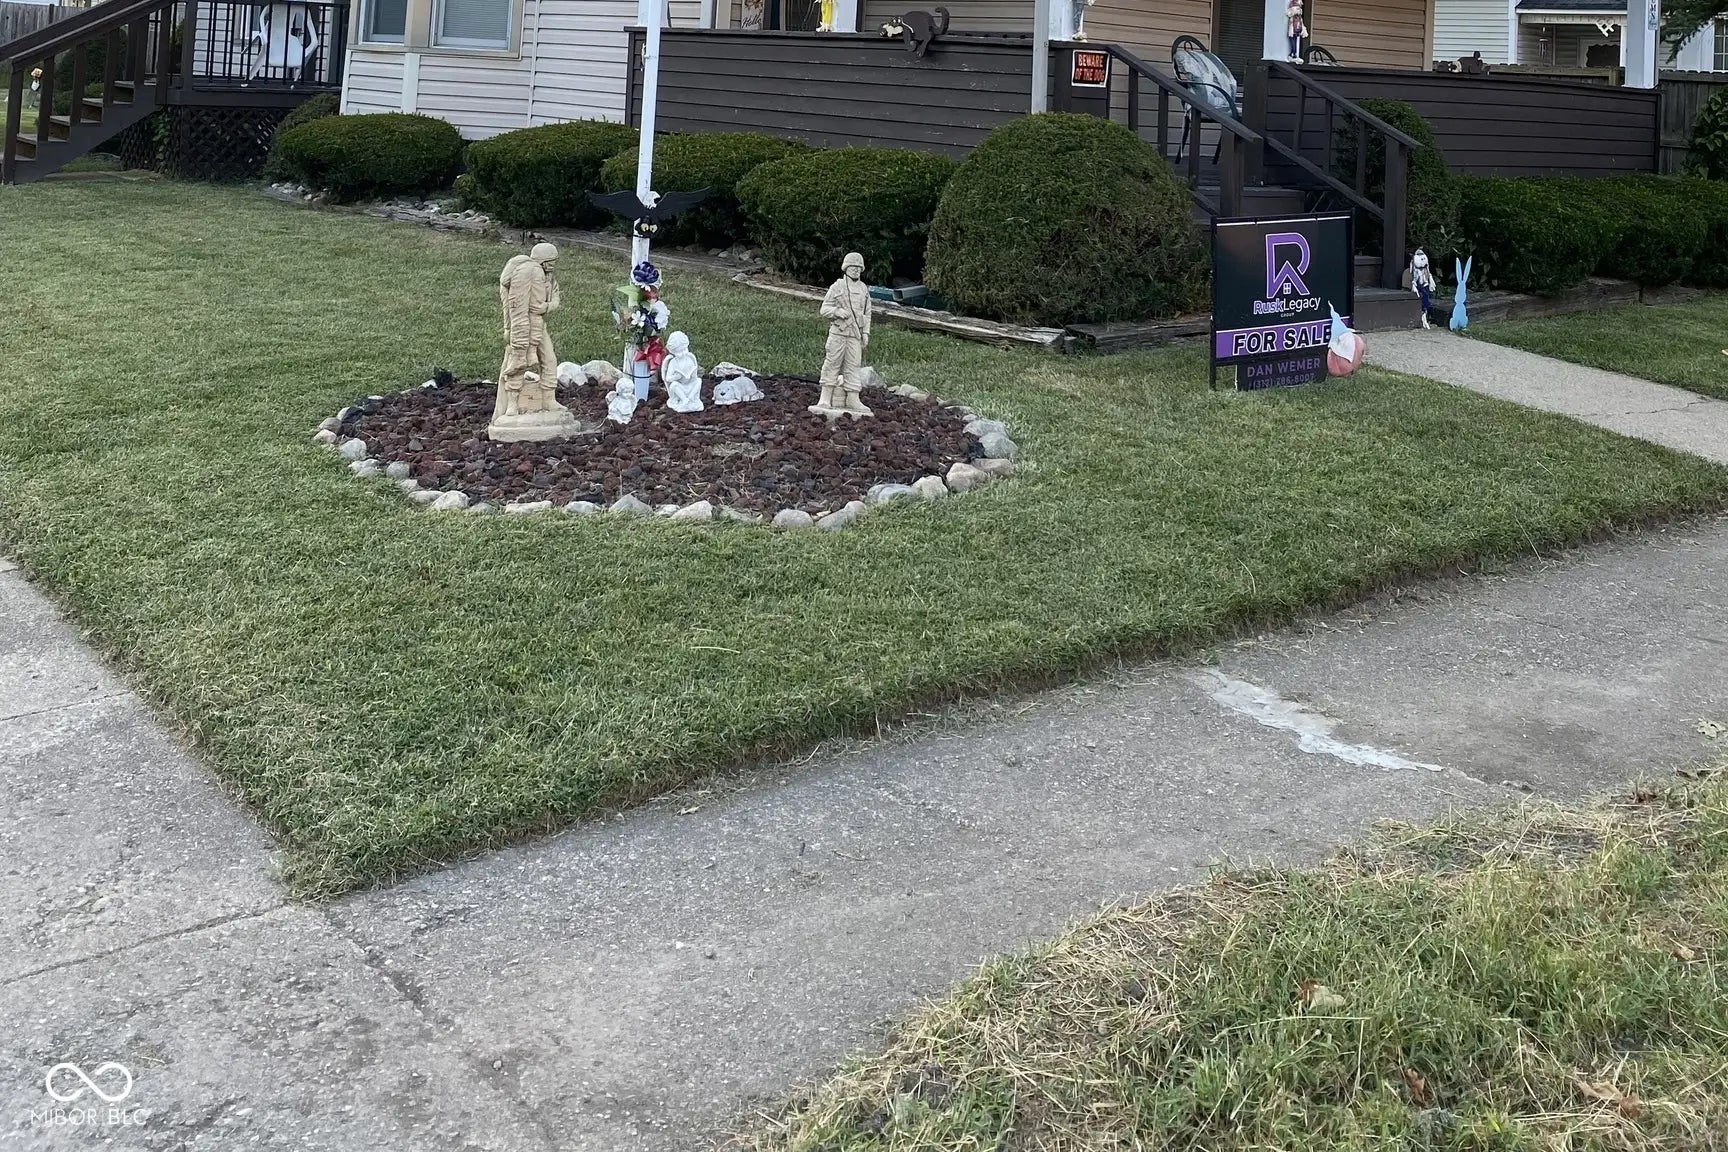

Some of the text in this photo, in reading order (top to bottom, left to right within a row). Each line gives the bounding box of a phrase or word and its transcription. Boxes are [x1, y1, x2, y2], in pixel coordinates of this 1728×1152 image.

[1078, 54, 1104, 67] BEWARE
[1075, 68, 1105, 81] OF THE DOG
[1232, 325, 1332, 356] FOR SALE
[1247, 357, 1321, 378] DAN WEMER
